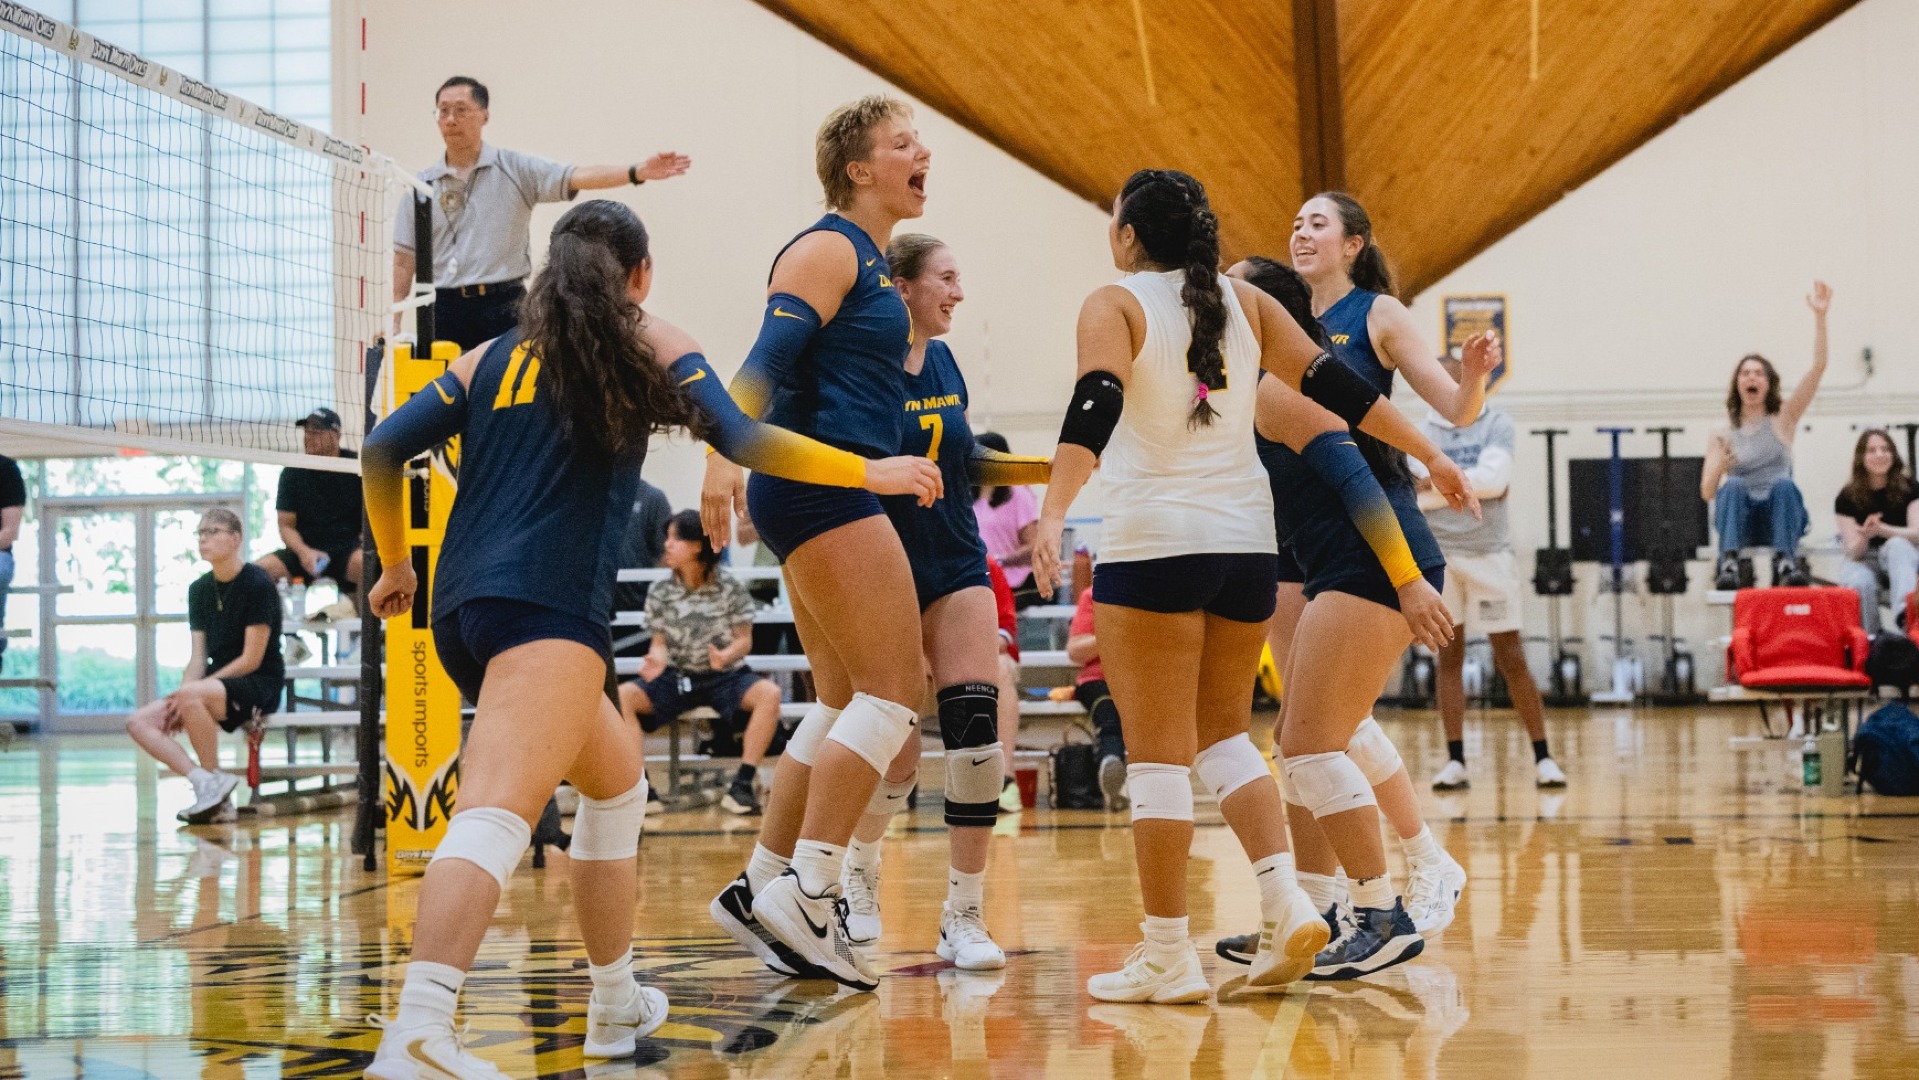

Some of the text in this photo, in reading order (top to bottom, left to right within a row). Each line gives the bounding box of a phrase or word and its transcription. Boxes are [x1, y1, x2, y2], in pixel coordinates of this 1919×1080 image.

[492, 340, 543, 411] 11
[922, 394, 961, 409] MAWR
[919, 414, 943, 461] 7
[412, 641, 428, 768] sports imports
[966, 685, 995, 694] NEENCA
